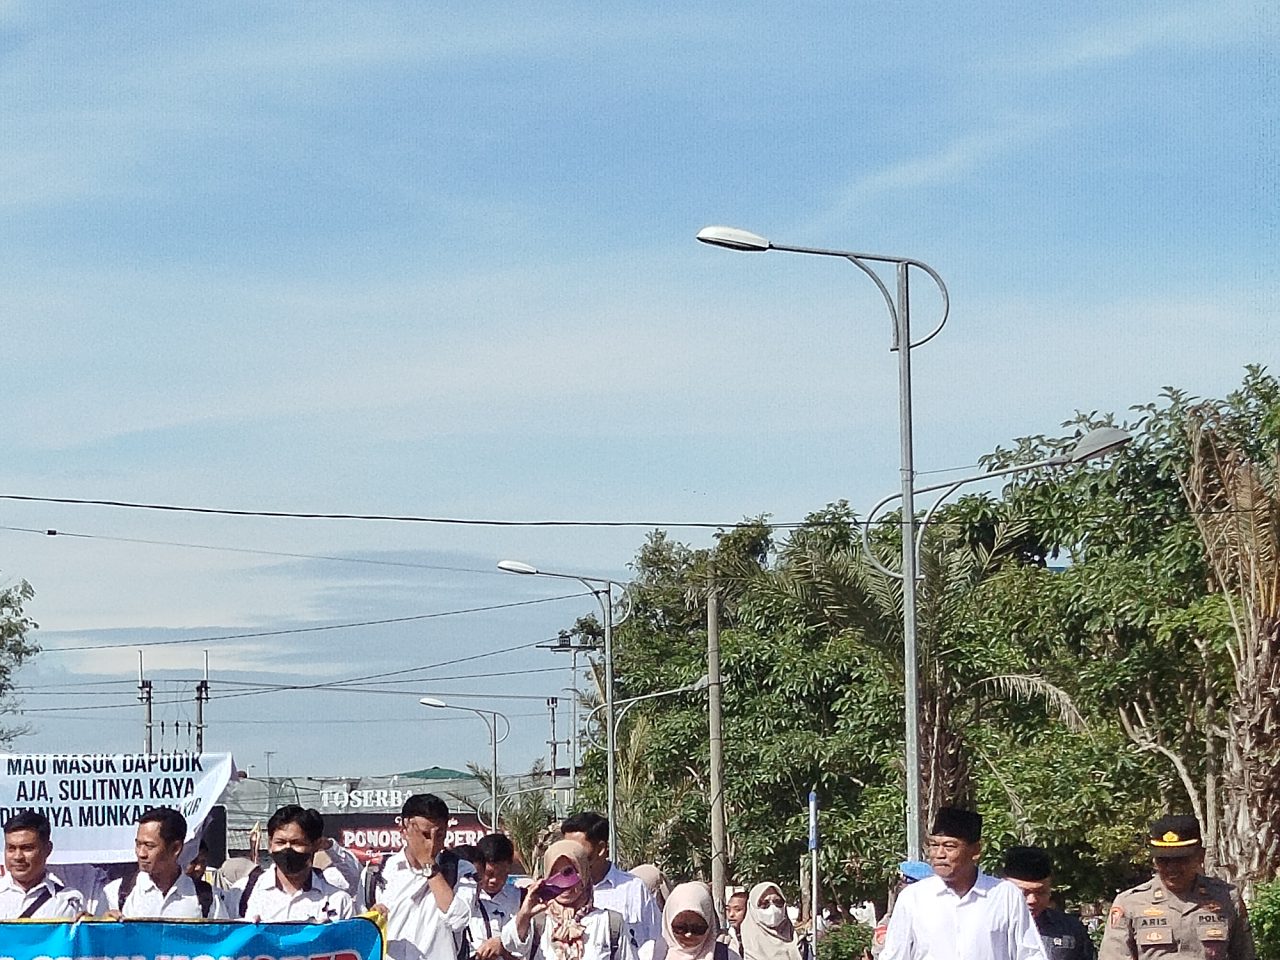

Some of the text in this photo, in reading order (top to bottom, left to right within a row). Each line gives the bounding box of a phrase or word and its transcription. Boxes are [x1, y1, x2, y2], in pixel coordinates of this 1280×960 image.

[7, 755, 46, 775] MAU
[53, 754, 117, 774] MASUK
[17, 777, 194, 804] AJA, SULITNYA KAYA
[343, 830, 404, 848] PONOR
[1141, 918, 1168, 926] ARIS
